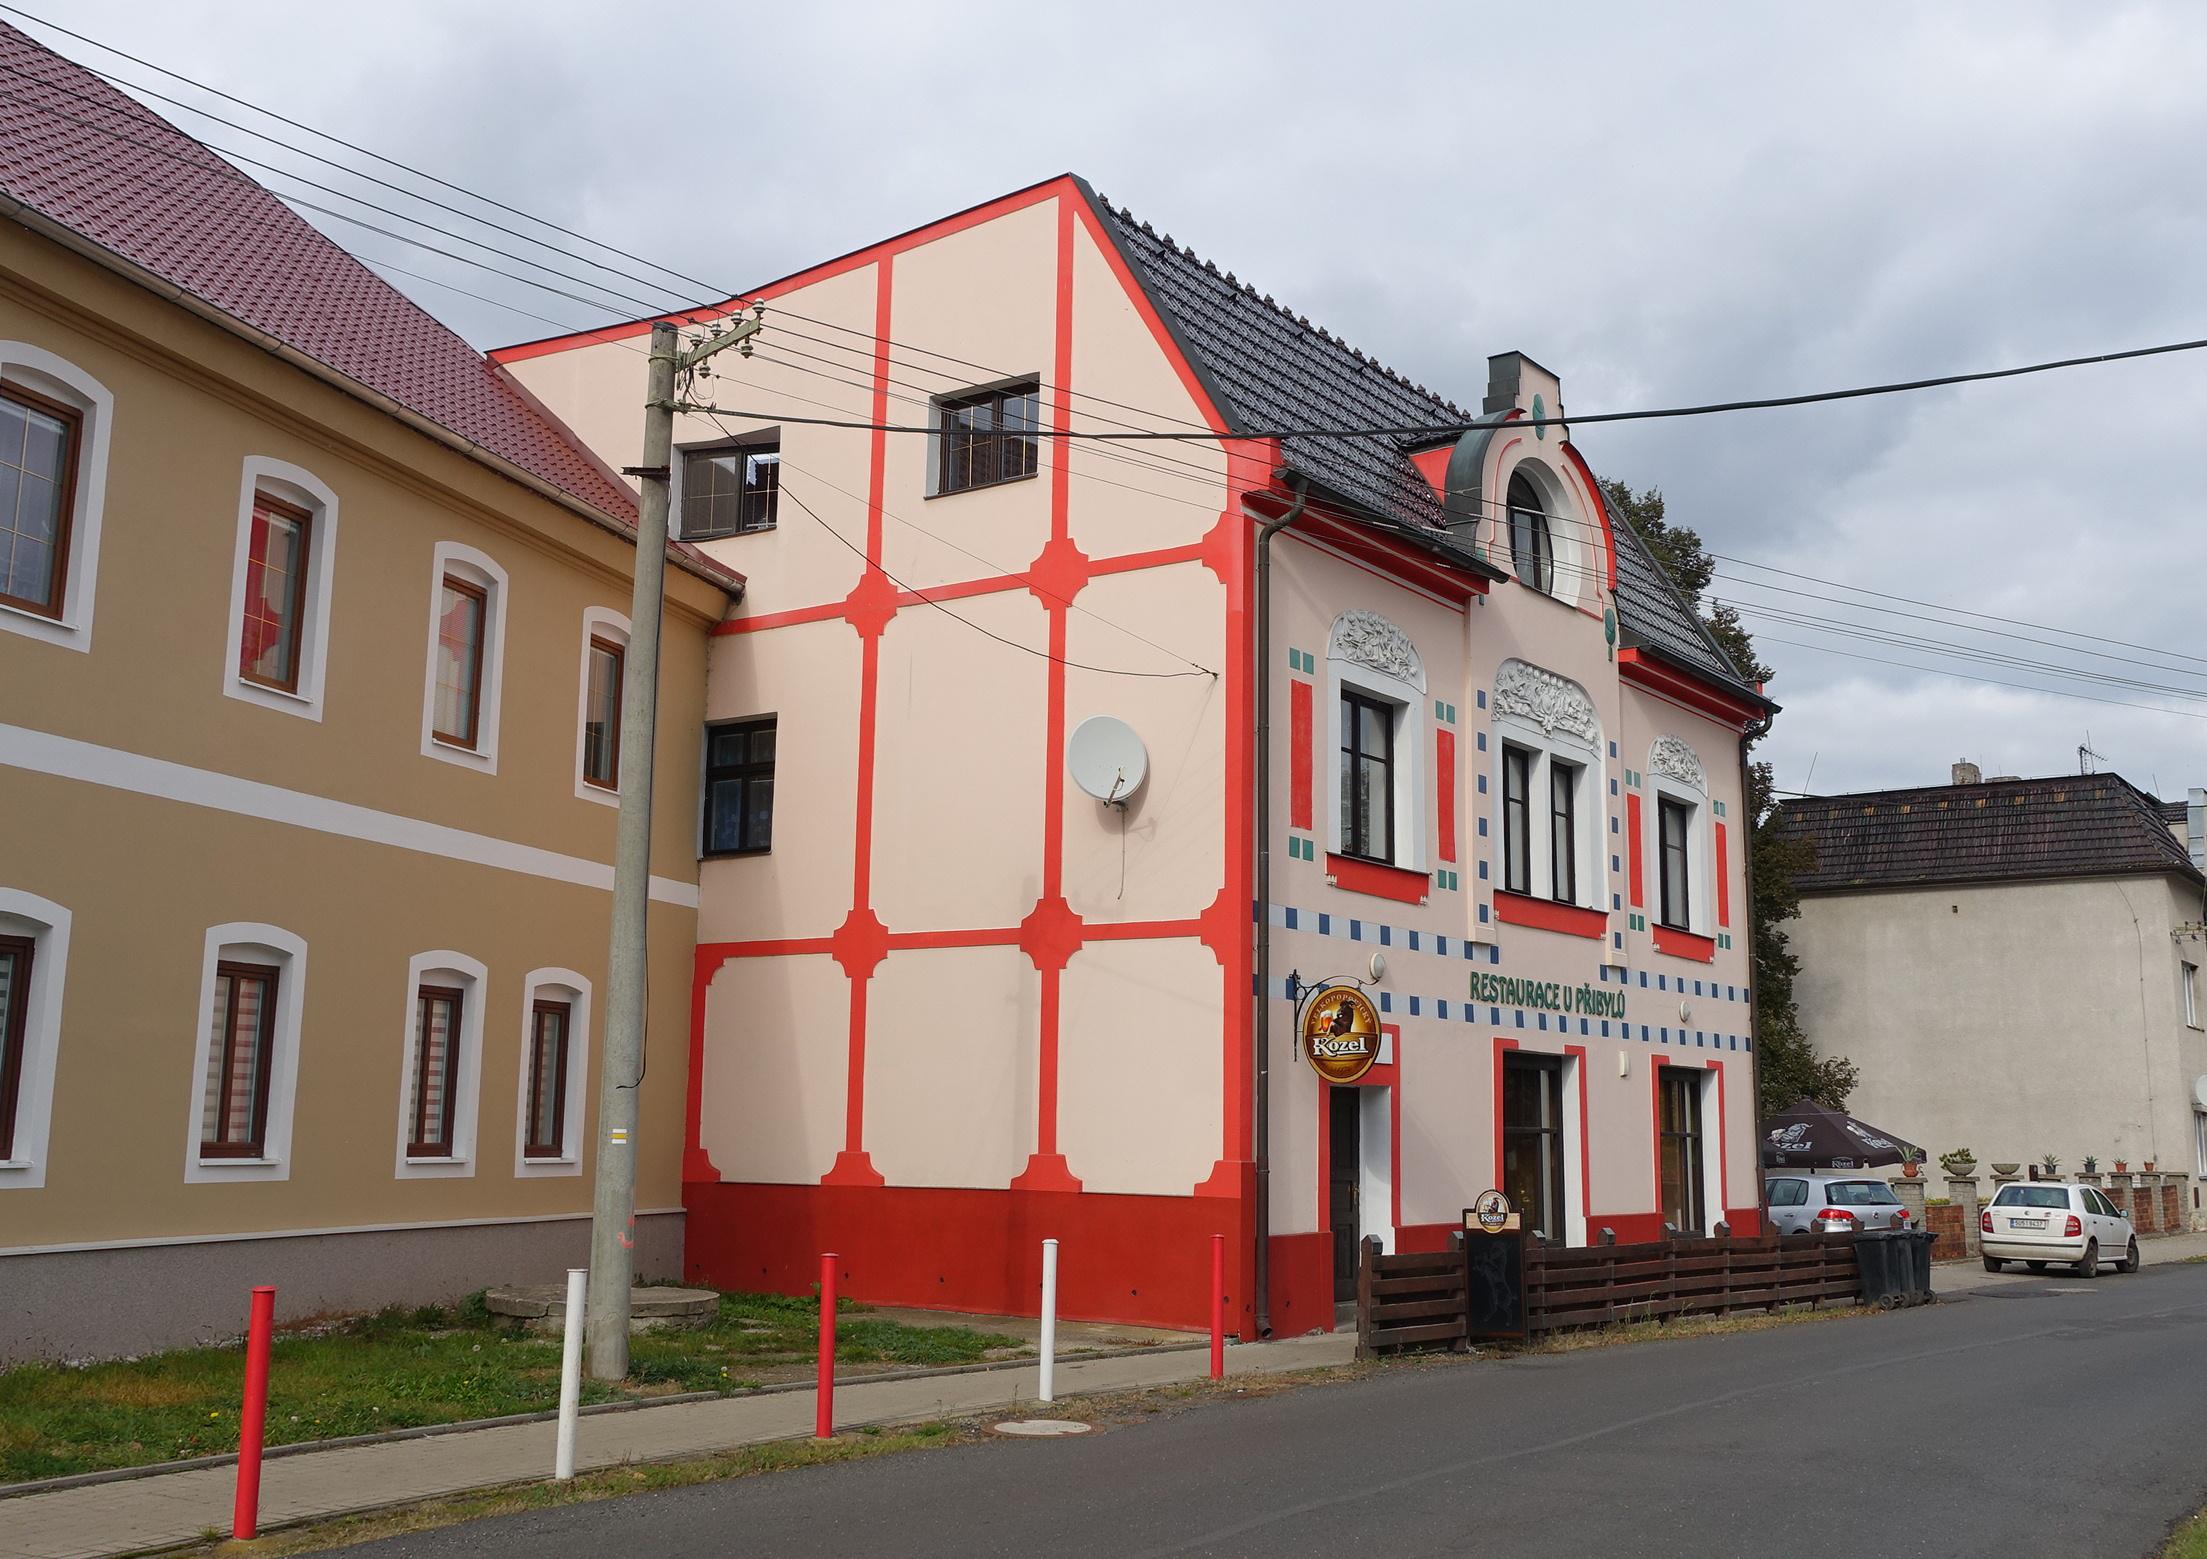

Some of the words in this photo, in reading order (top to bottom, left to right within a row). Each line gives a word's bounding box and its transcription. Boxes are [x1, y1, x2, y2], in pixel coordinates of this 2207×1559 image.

[1469, 971, 1561, 1011] RESTAURACE
[1563, 985, 1572, 1012] U
[1313, 1037, 1369, 1057] Kozel
[1481, 1213, 1504, 1223] Kozel
